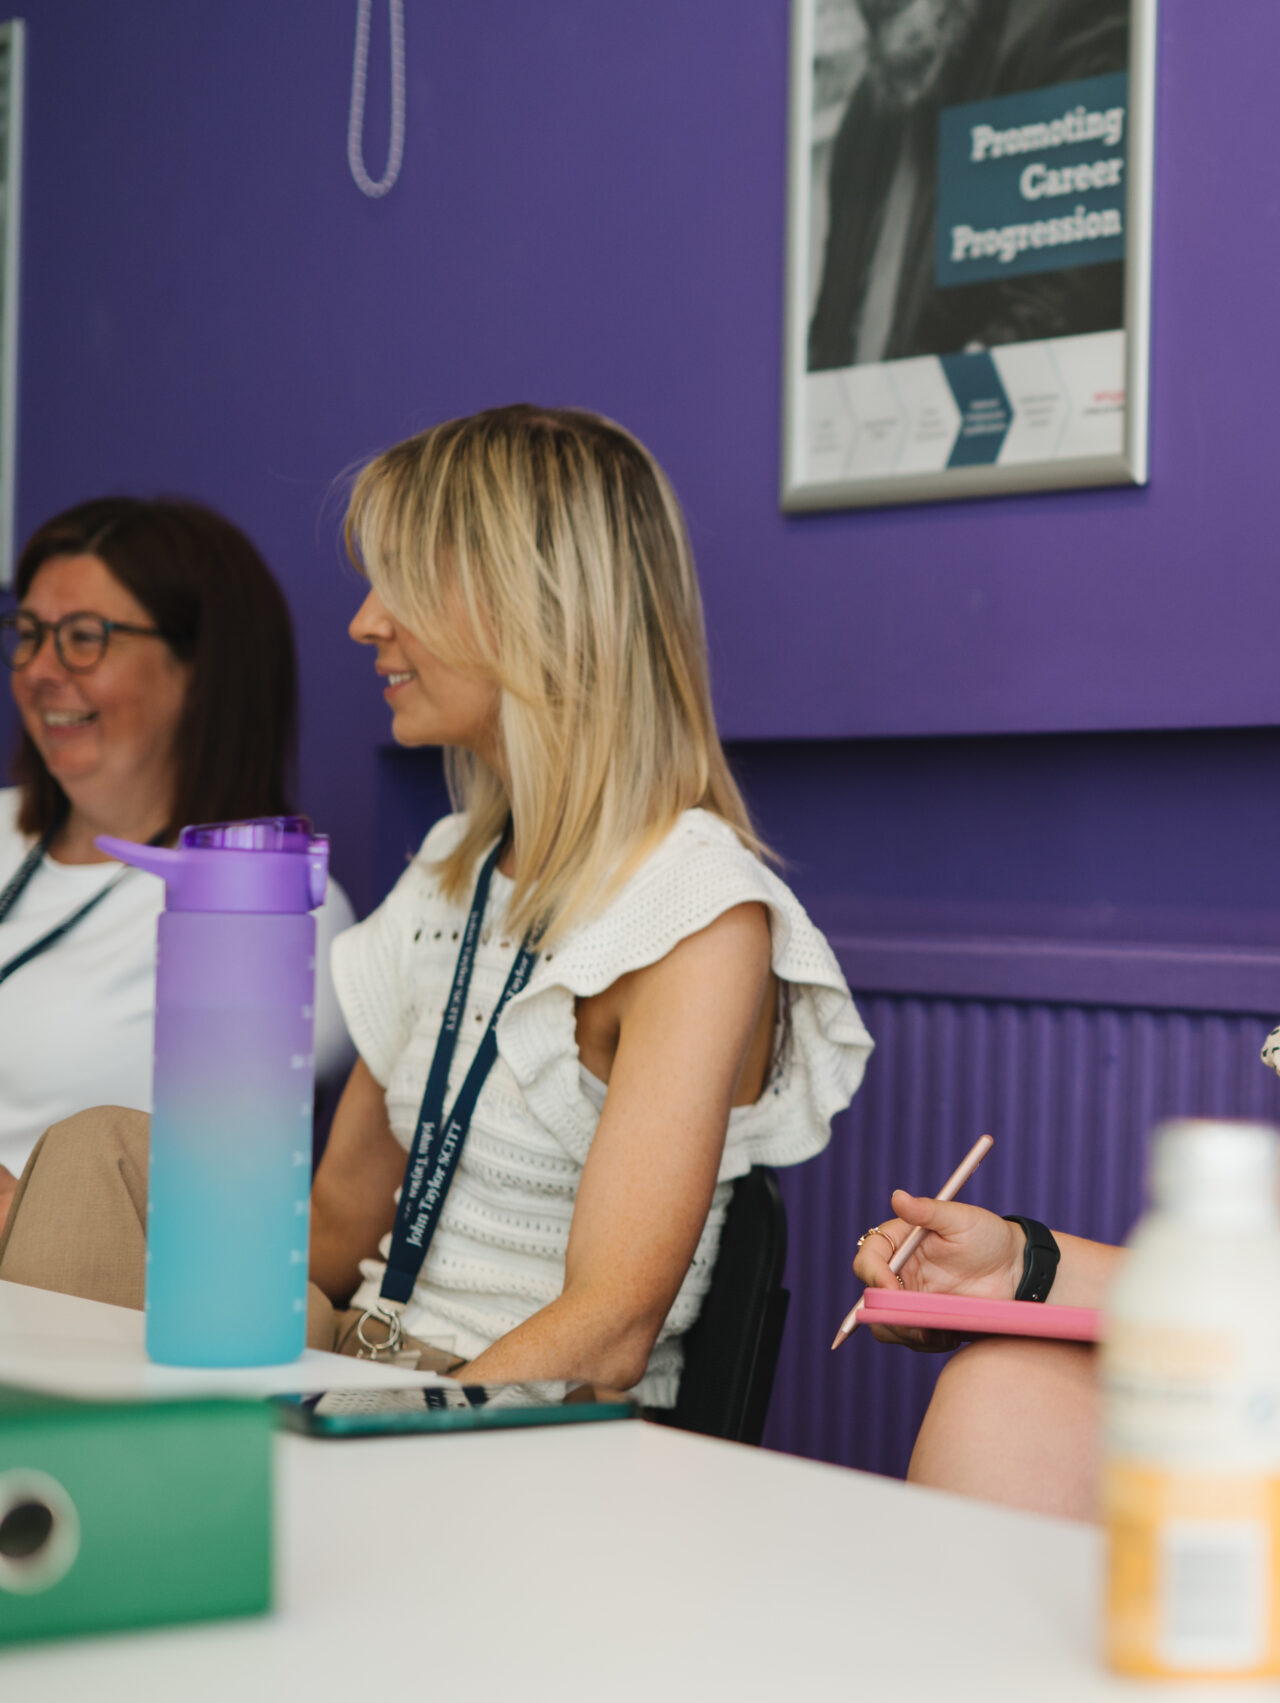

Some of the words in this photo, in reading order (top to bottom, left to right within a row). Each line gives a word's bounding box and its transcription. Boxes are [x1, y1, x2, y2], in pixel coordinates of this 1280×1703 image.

[970, 105, 1125, 162] Promoting
[1020, 157, 1124, 201] Career
[951, 204, 1123, 263] Progression
[406, 1212, 429, 1247] John
[418, 1165, 446, 1211] Taylor
[438, 1119, 462, 1167] SCITT
